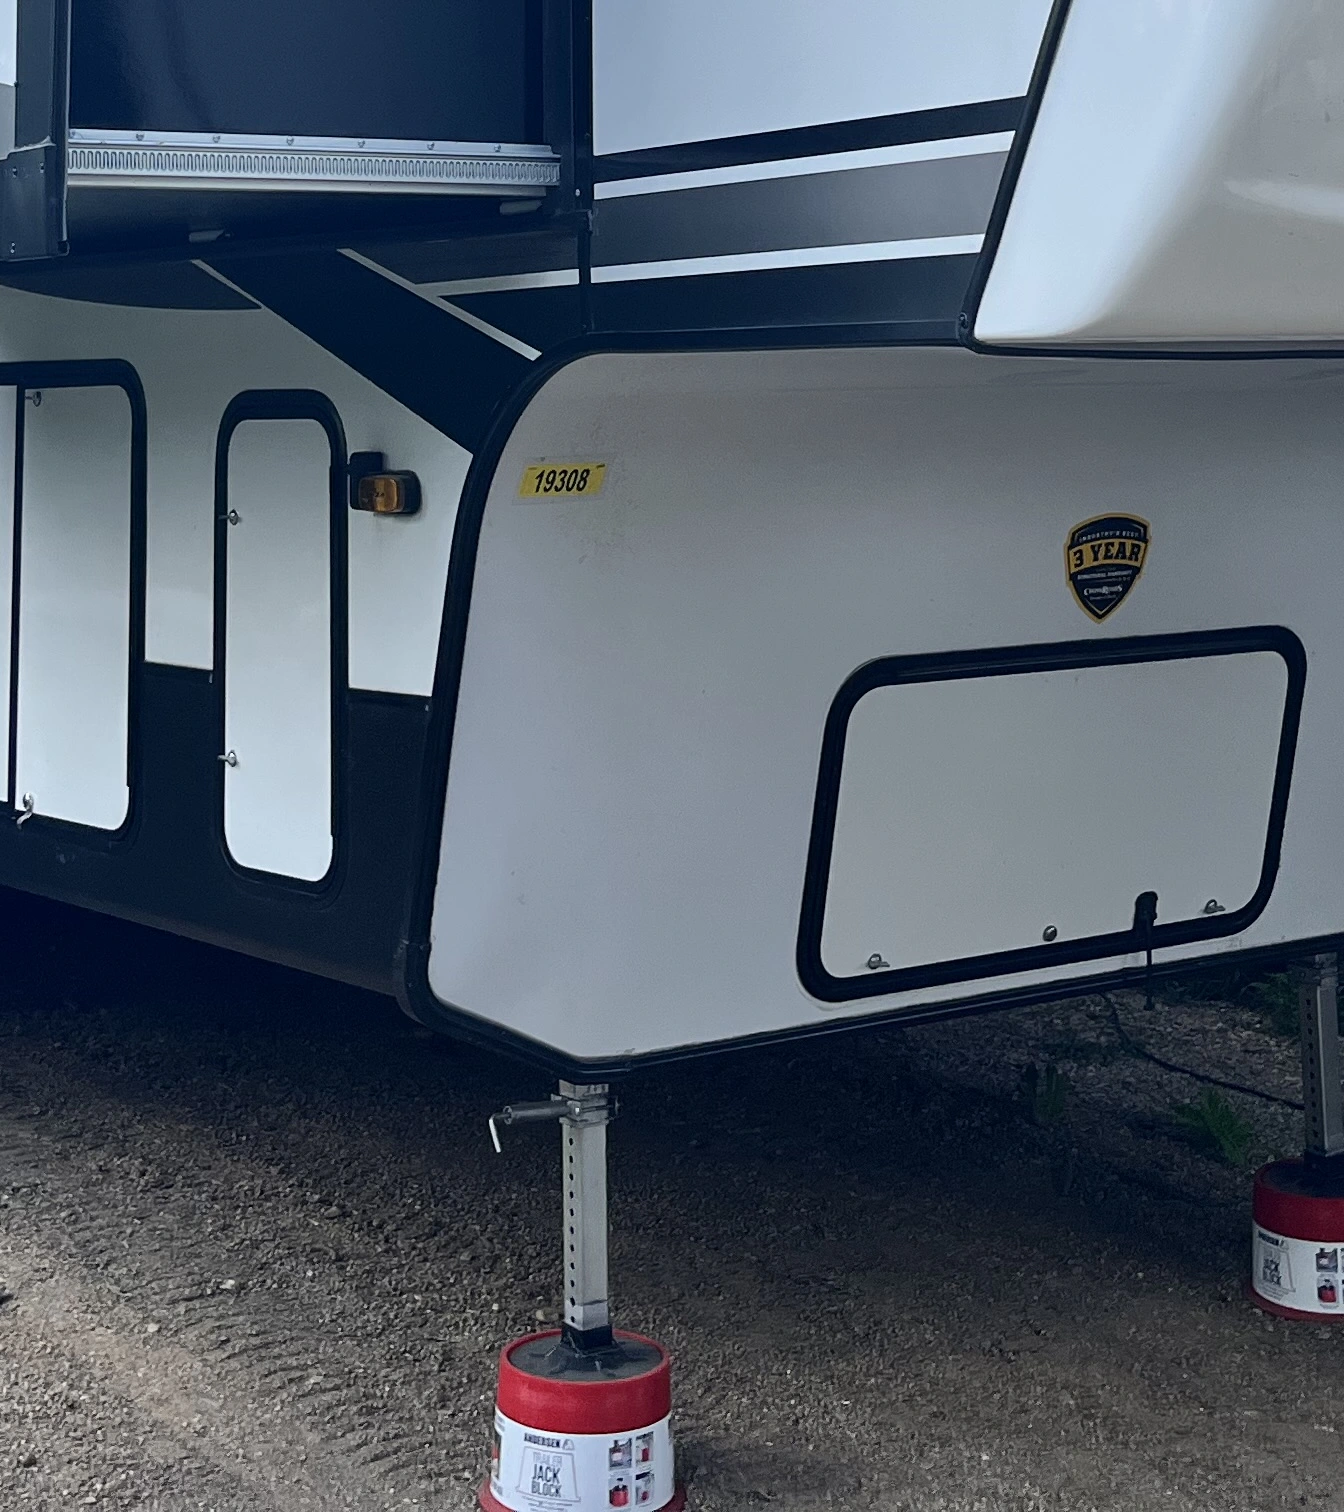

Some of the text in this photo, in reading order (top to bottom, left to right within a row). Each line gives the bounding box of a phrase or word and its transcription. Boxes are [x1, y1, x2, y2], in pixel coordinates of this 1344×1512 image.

[535, 468, 591, 493] 19308
[1073, 541, 1142, 568] 3 YEAR
[532, 1464, 561, 1484] JACK
[531, 1480, 562, 1498] BLOCK
